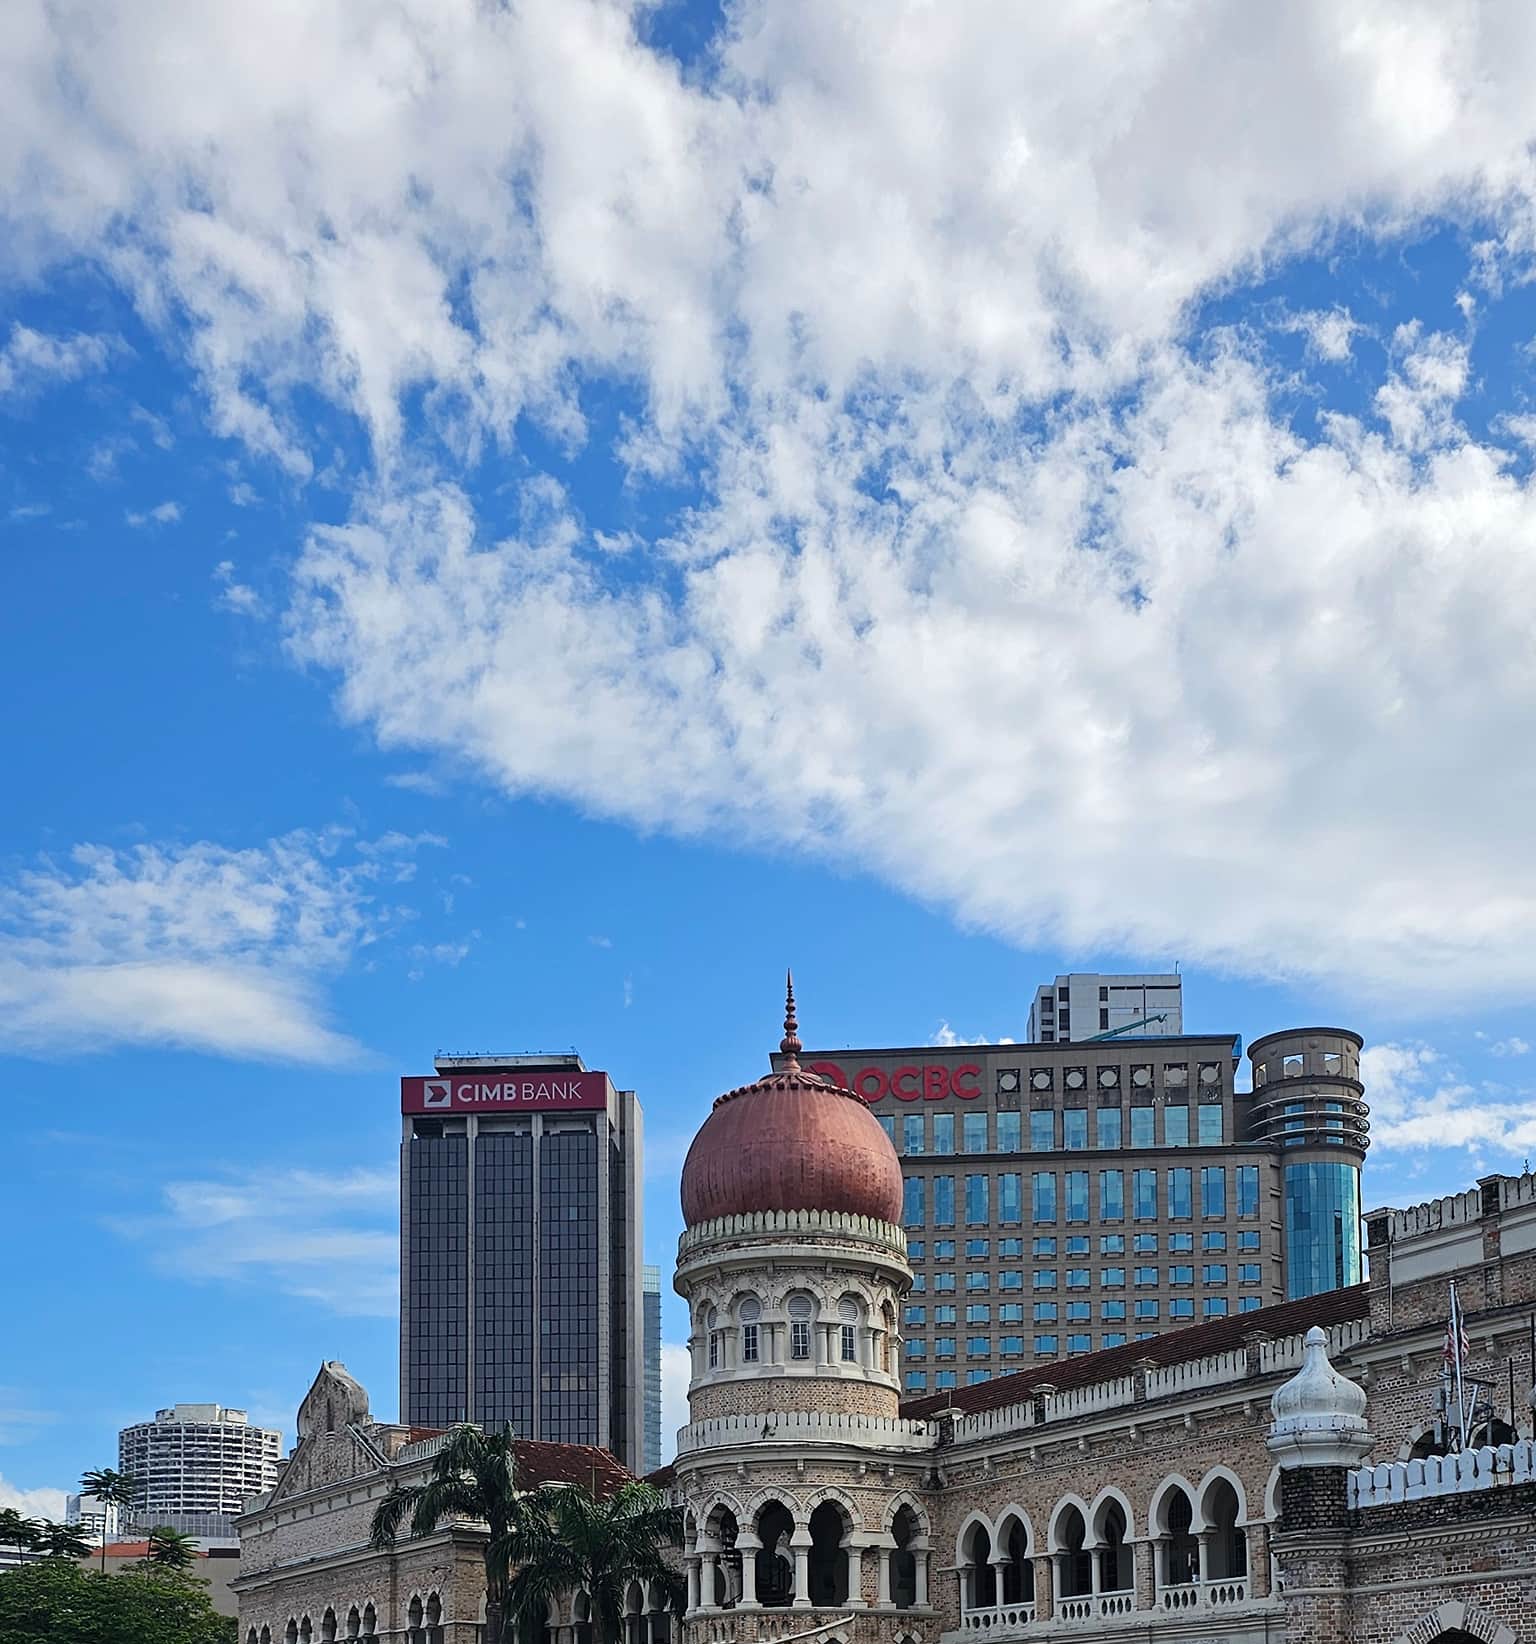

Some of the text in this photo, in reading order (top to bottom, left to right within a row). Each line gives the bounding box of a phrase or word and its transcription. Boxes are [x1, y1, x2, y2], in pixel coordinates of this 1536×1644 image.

[457, 1081, 582, 1102] CIMB BANK
[853, 1063, 982, 1103] OCBC
